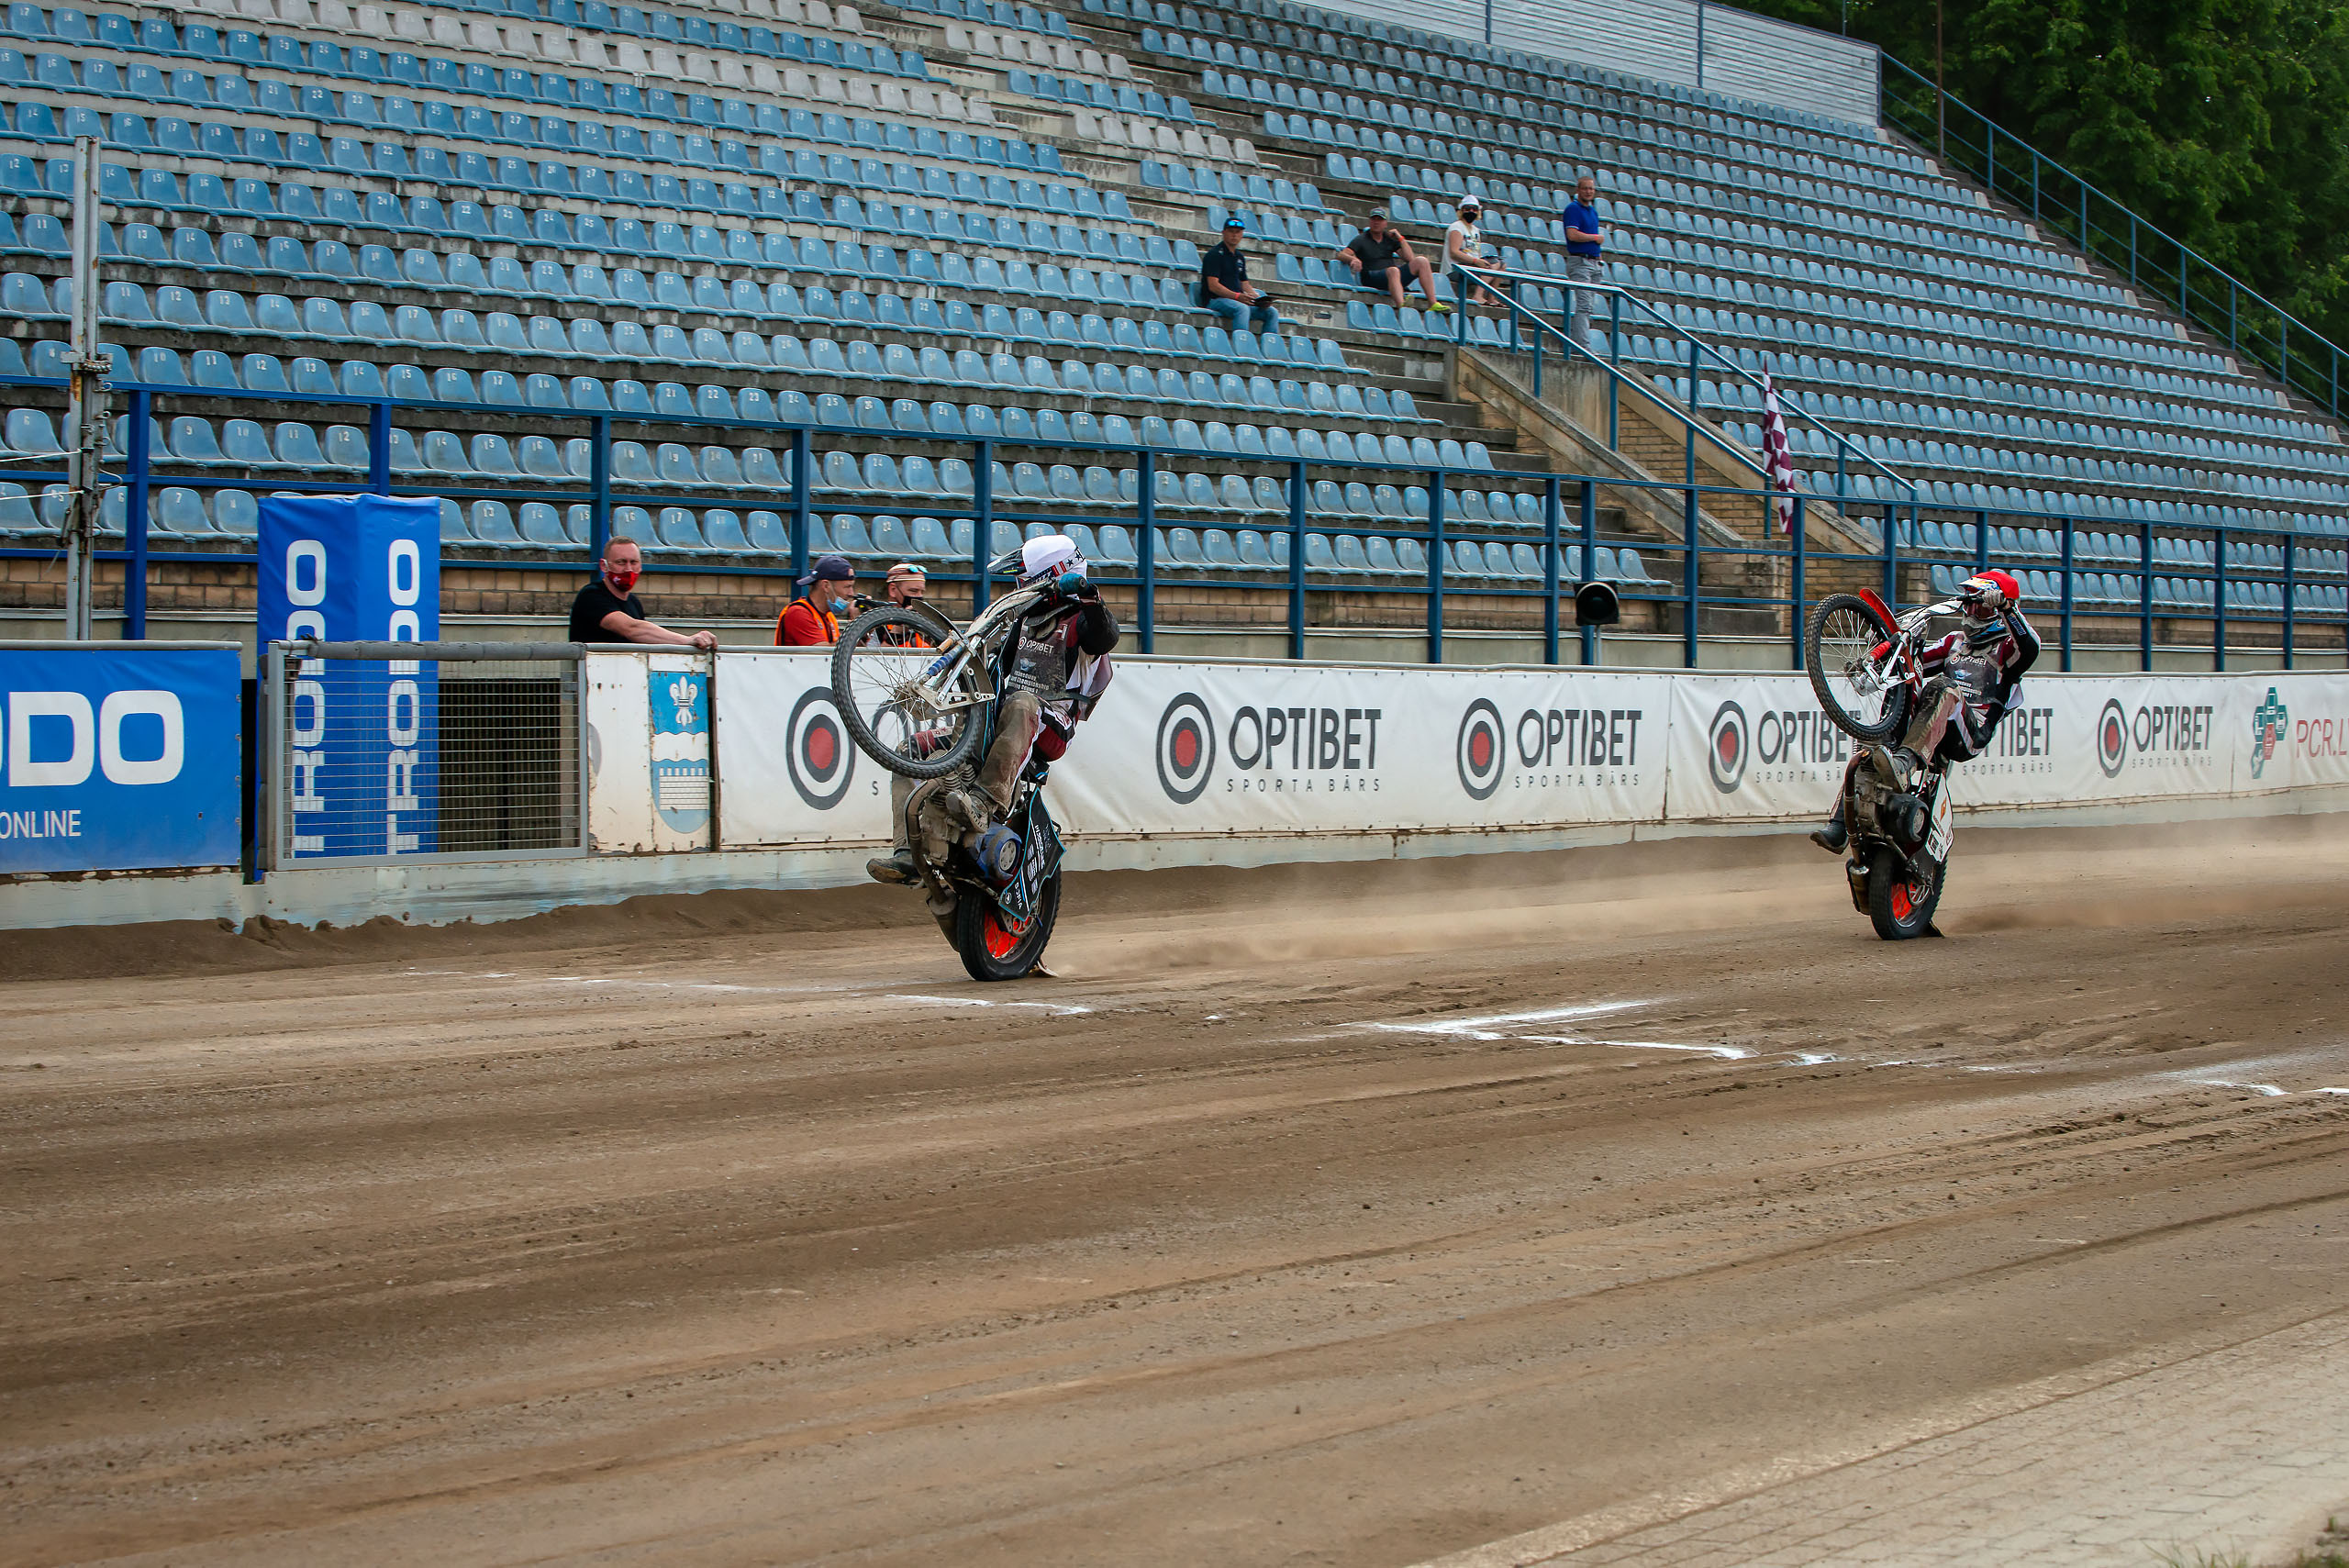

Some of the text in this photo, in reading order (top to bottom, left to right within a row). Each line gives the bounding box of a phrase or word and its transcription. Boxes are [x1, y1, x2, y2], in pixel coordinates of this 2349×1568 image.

[20, 7, 29, 16] 17
[107, 19, 117, 28] 19
[150, 24, 161, 33] 20
[195, 28, 205, 39] 21
[238, 34, 248, 42] 22
[279, 39, 289, 50] 23
[319, 44, 328, 53] 24
[359, 50, 368, 60] 25
[397, 55, 408, 64] 26
[48, 59, 57, 68] 16
[94, 63, 104, 72] 17
[436, 61, 447, 71] 27
[473, 66, 484, 75] 28
[184, 73, 193, 83] 19
[268, 84, 278, 95] 21
[312, 89, 323, 99] 22
[618, 87, 629, 95] 32
[352, 95, 362, 104] 23
[28, 108, 39, 117] 14
[431, 105, 440, 114] 25
[77, 112, 85, 122] 15
[510, 116, 521, 124] 27
[168, 122, 177, 132] 17
[383, 145, 393, 155] 22
[425, 150, 435, 160] 23
[9, 158, 19, 169] 12
[467, 154, 476, 164] 24
[59, 163, 69, 172] 13
[507, 160, 517, 169] 25
[106, 169, 115, 178] 14
[152, 172, 164, 183] 15
[586, 168, 596, 178] 27
[200, 178, 209, 187] 16
[246, 183, 255, 193] 17
[767, 190, 775, 198] 32
[377, 195, 387, 205] 20
[420, 200, 429, 209] 21
[461, 206, 471, 214] 22
[503, 208, 513, 218] 23
[544, 213, 554, 222] 24
[584, 217, 594, 228] 25
[37, 218, 47, 228] 11
[624, 222, 633, 231] 26
[138, 229, 147, 239] 13
[662, 225, 673, 233] 27
[185, 232, 195, 242] 14
[233, 239, 243, 248] 15
[279, 240, 289, 251] 16
[326, 245, 336, 256] 17
[542, 265, 553, 275] 22
[624, 273, 633, 283] 24
[663, 275, 674, 284] 25
[121, 286, 130, 296] 11
[740, 284, 749, 294] 27
[171, 290, 182, 301] 12
[219, 295, 229, 305] 13
[270, 298, 280, 308] 14
[317, 301, 327, 312] 15
[407, 308, 418, 318] 17
[454, 314, 464, 323] 18
[154, 352, 166, 362] 10
[206, 355, 217, 365] 11
[257, 360, 266, 370] 12
[305, 362, 316, 373] 13
[353, 367, 363, 375] 14
[402, 369, 411, 379] 15
[446, 373, 457, 382] 16
[493, 375, 503, 385] 17
[665, 387, 675, 397] 21
[707, 389, 718, 398] 22
[749, 392, 759, 402] 23
[788, 395, 798, 404] 24
[827, 396, 839, 406] 25
[864, 400, 873, 409] 26
[902, 402, 912, 411] 27
[1079, 417, 1088, 425] 32
[186, 426, 193, 435] 9
[339, 431, 350, 441] 12
[389, 434, 398, 444] 13
[437, 437, 447, 446] 14
[484, 439, 495, 450] 15
[532, 440, 543, 451] 16
[670, 452, 679, 462] 19
[752, 452, 763, 462] 21
[117, 492, 125, 502] 6
[176, 492, 182, 503] 7
[483, 506, 494, 517] 13
[580, 510, 590, 521] 15
[624, 512, 635, 522] 16
[672, 512, 683, 524] 17
[883, 521, 892, 532] 22
[1026, 639, 1054, 654] OPTIBET
[286, 539, 327, 858] TRODO
[387, 539, 420, 855] TRODO
[2133, 706, 2213, 752] OPTIBET
[0, 690, 184, 787] DO
[1229, 706, 1382, 770] OPTIBET
[1517, 708, 1642, 768] OPTIBET
[1758, 710, 1861, 765] OPTIBE
[2297, 718, 2349, 759] PCR.L
[1515, 771, 1640, 789] SPORTA BĀRS
[1755, 771, 1817, 784] SPORTA
[1227, 774, 1380, 793] SPORTA BĀRS
[0, 809, 81, 840] ONLINE
